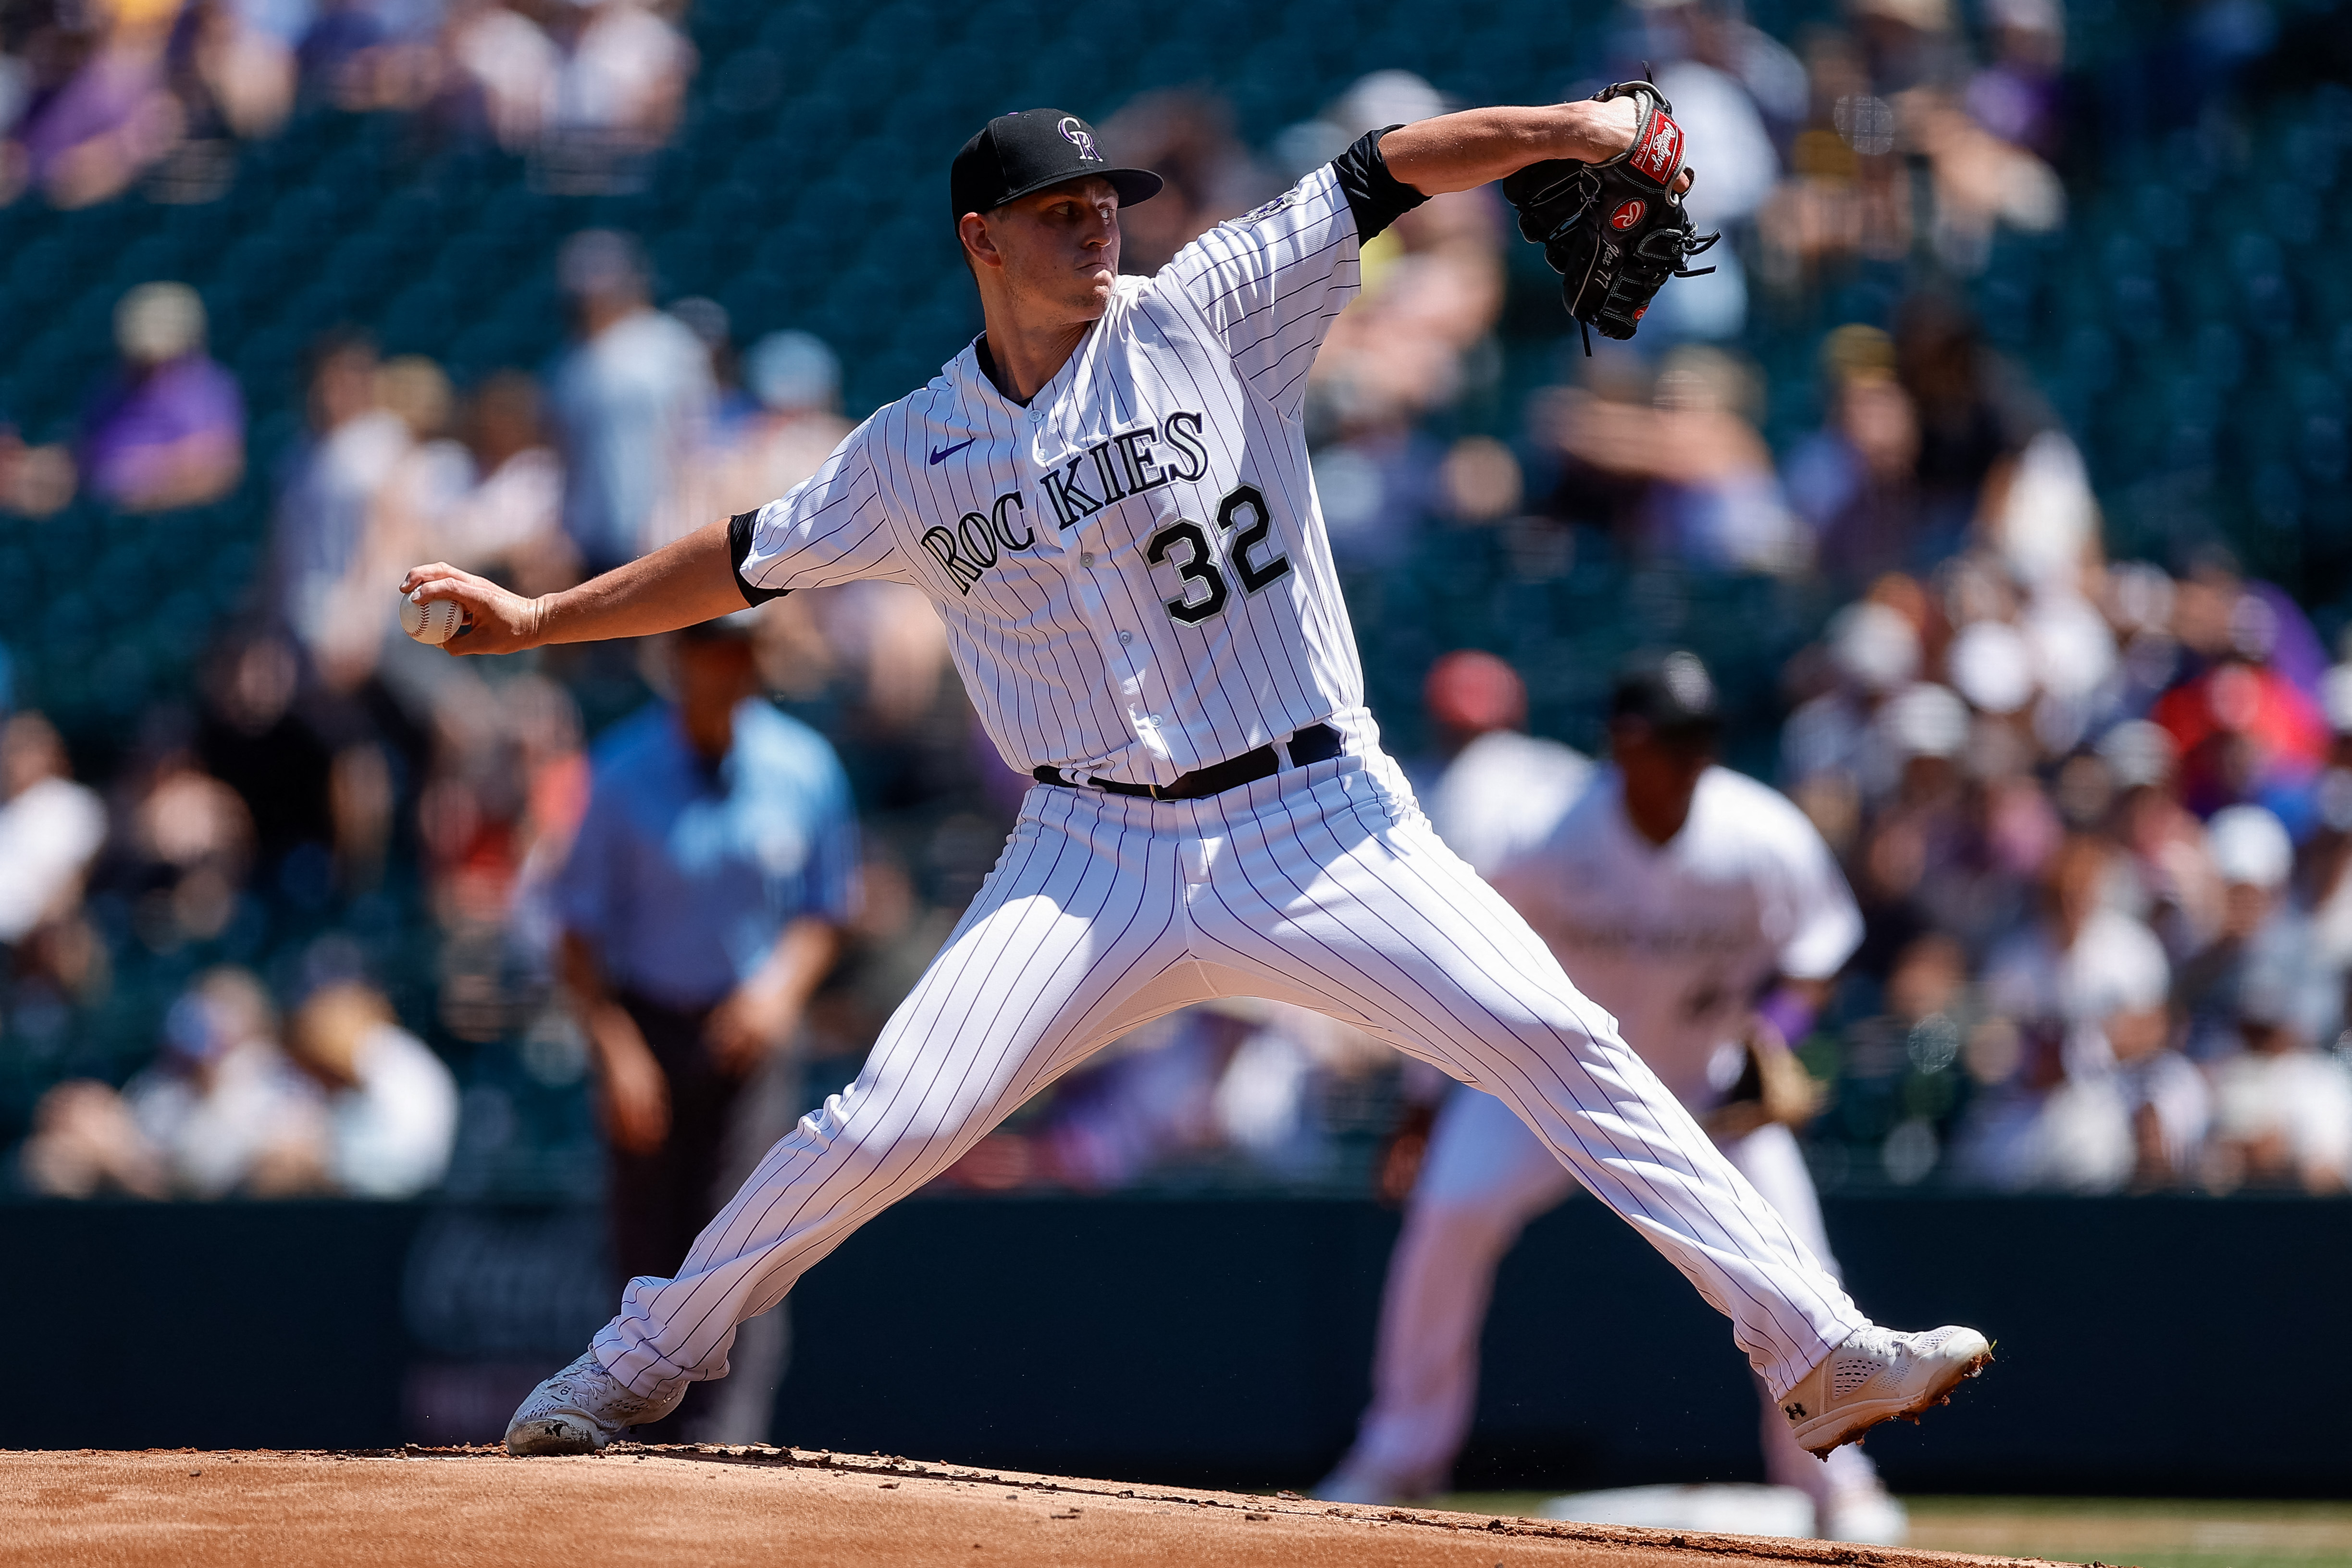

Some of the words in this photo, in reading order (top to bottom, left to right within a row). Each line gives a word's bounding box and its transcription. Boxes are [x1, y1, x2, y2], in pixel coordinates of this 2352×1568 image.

[1651, 122, 1676, 172] Rawlings
[1595, 270, 1612, 289] 77
[1143, 481, 1295, 630] 32
